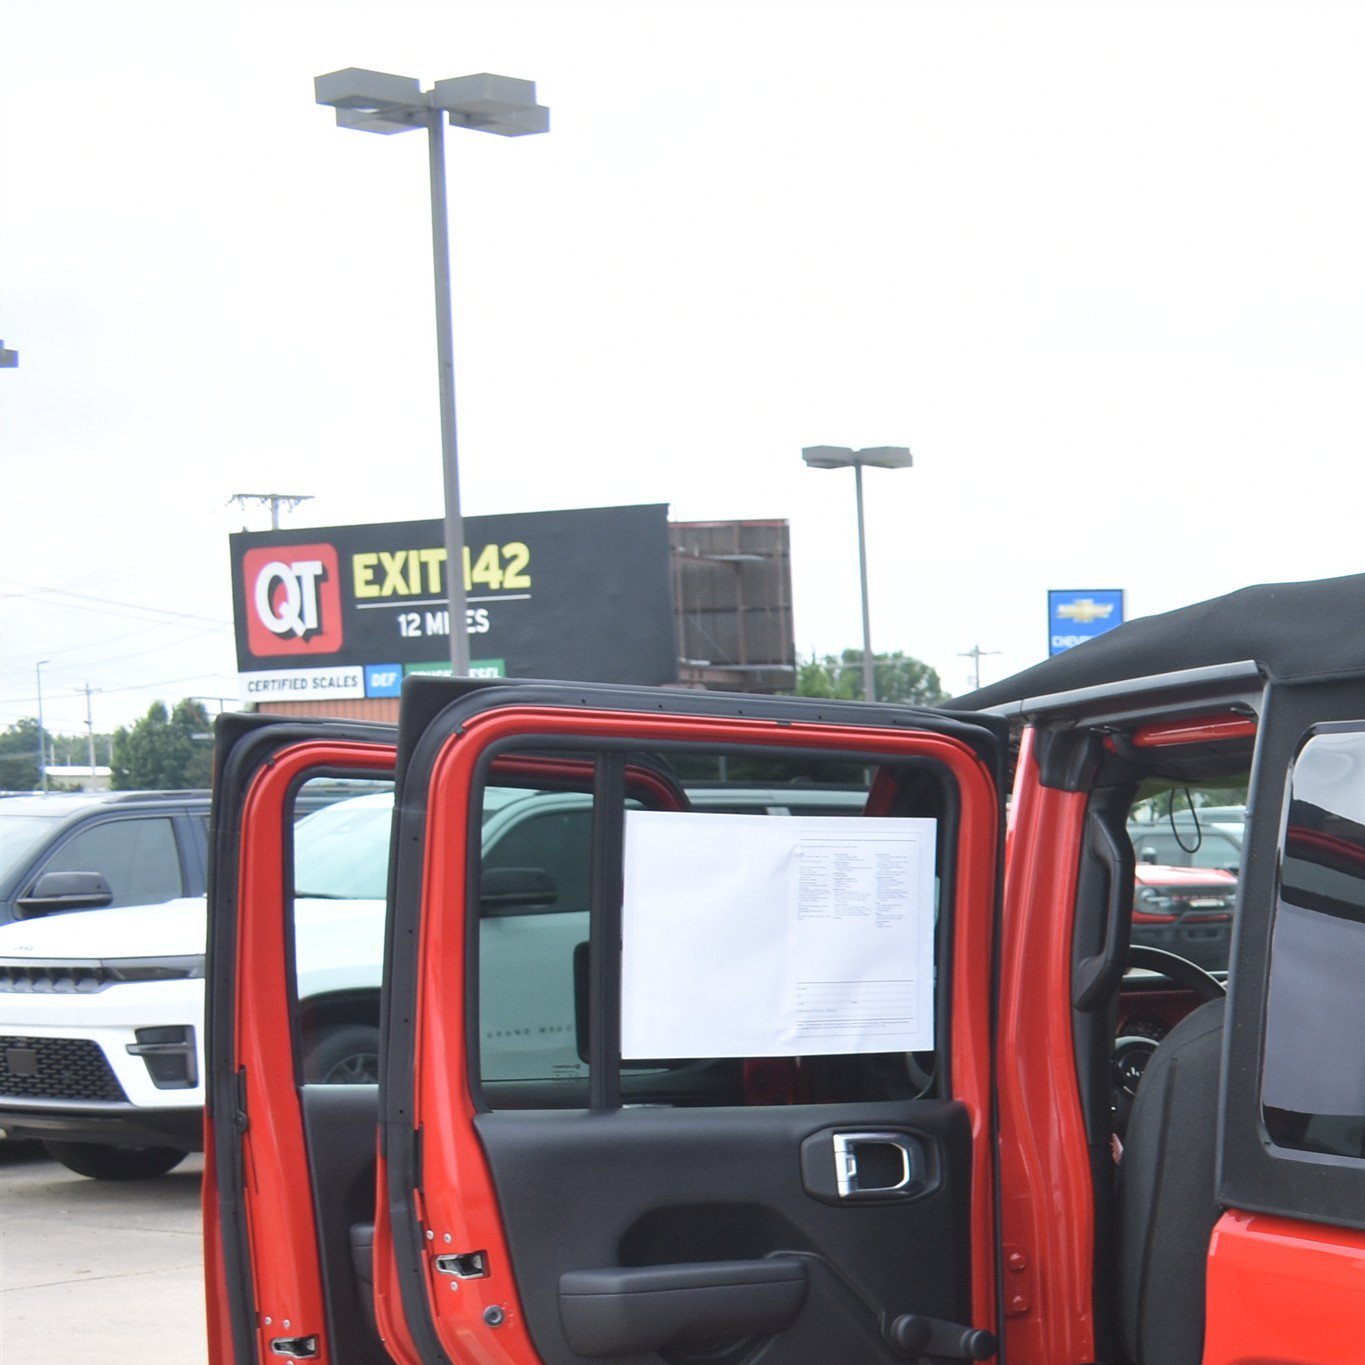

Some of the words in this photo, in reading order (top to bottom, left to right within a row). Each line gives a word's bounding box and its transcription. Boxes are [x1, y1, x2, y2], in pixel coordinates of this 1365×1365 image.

[353, 548, 448, 598] EXIT
[461, 541, 532, 592] 142
[254, 560, 323, 637] QT
[398, 612, 423, 637] 12
[426, 608, 490, 636] MIES
[247, 677, 308, 692] CERTIFIED
[312, 675, 358, 689] SCALES
[370, 672, 398, 687] DEF
